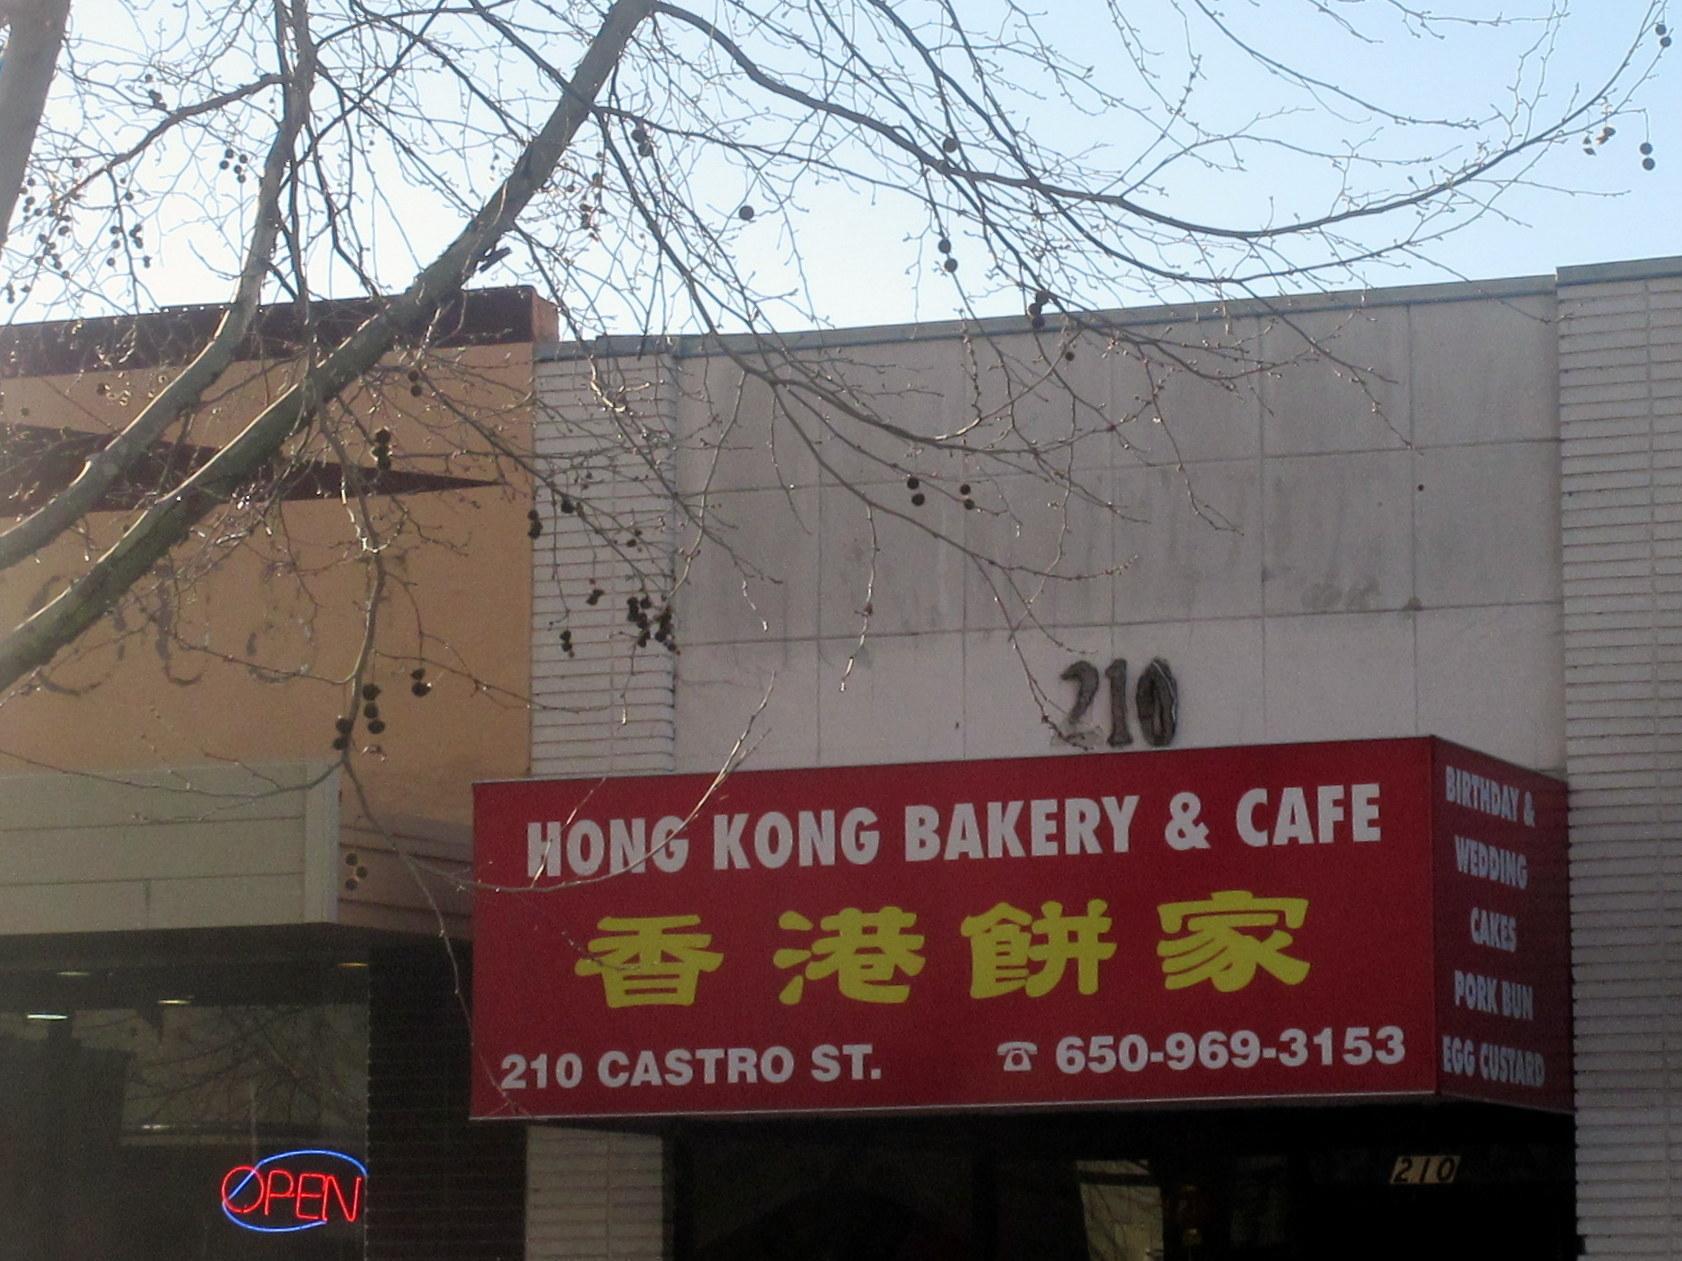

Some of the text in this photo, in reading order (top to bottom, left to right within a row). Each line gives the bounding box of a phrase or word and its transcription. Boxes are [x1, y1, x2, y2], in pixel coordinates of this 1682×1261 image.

[1051, 658, 1178, 749] 210
[1445, 765, 1536, 828] BIRTHDAY &
[527, 782, 1382, 878] HONG KONG BAKERY & CAFE
[1454, 834, 1529, 890] WEDDING
[574, 890, 1311, 1009] 香港餅家
[1471, 907, 1517, 953] CAKES
[1454, 969, 1534, 1021] PORK BUN
[501, 1043, 883, 1090] 210 CASTRO ST.
[1055, 1026, 1406, 1076] 650-969-3153
[1442, 1035, 1546, 1088] EGG CUSTARD
[221, 1166, 363, 1224] OPEN
[1393, 1157, 1457, 1184] 210
